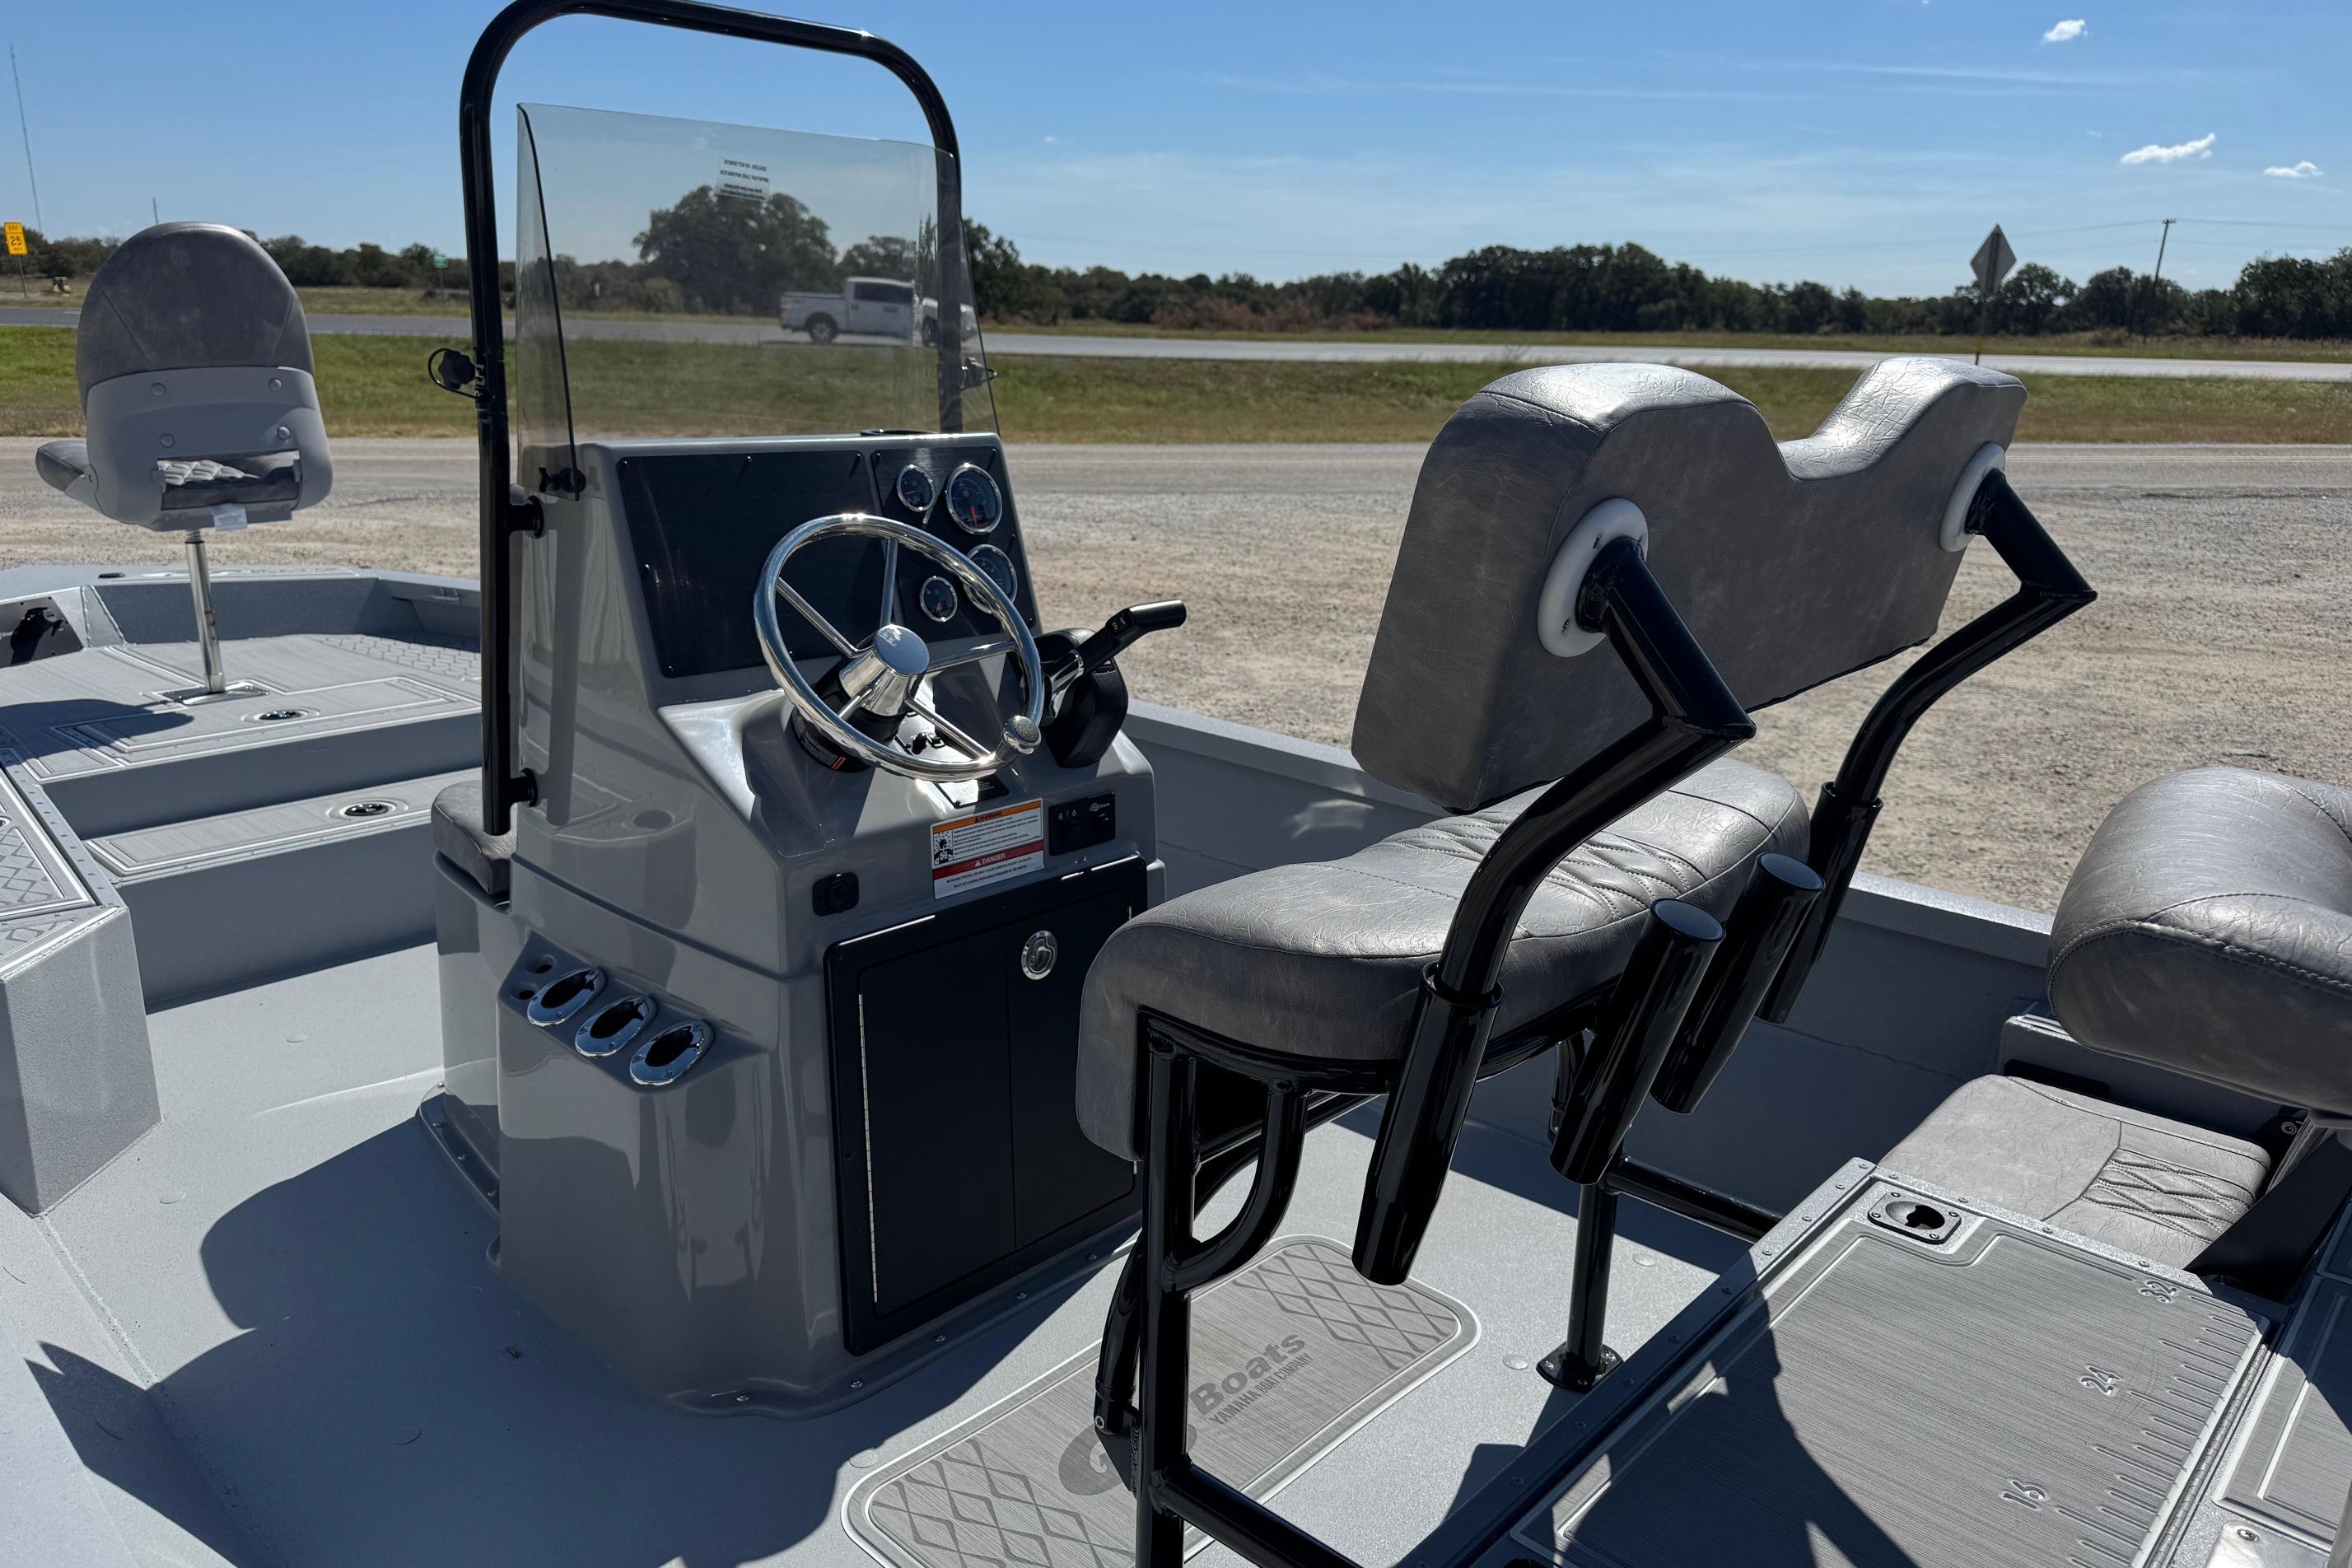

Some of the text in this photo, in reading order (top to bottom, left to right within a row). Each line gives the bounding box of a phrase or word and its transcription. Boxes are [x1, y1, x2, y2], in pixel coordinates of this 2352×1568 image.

[11, 236, 23, 245] 25
[982, 853, 1006, 864] DANGER
[2140, 1280, 2177, 1304] 32
[1190, 1334, 1305, 1416] Boats
[1209, 1352, 1314, 1425] YAMAHA BOAT COMPANY
[2079, 1365, 2121, 1396] 24
[2002, 1480, 2048, 1510] 16
